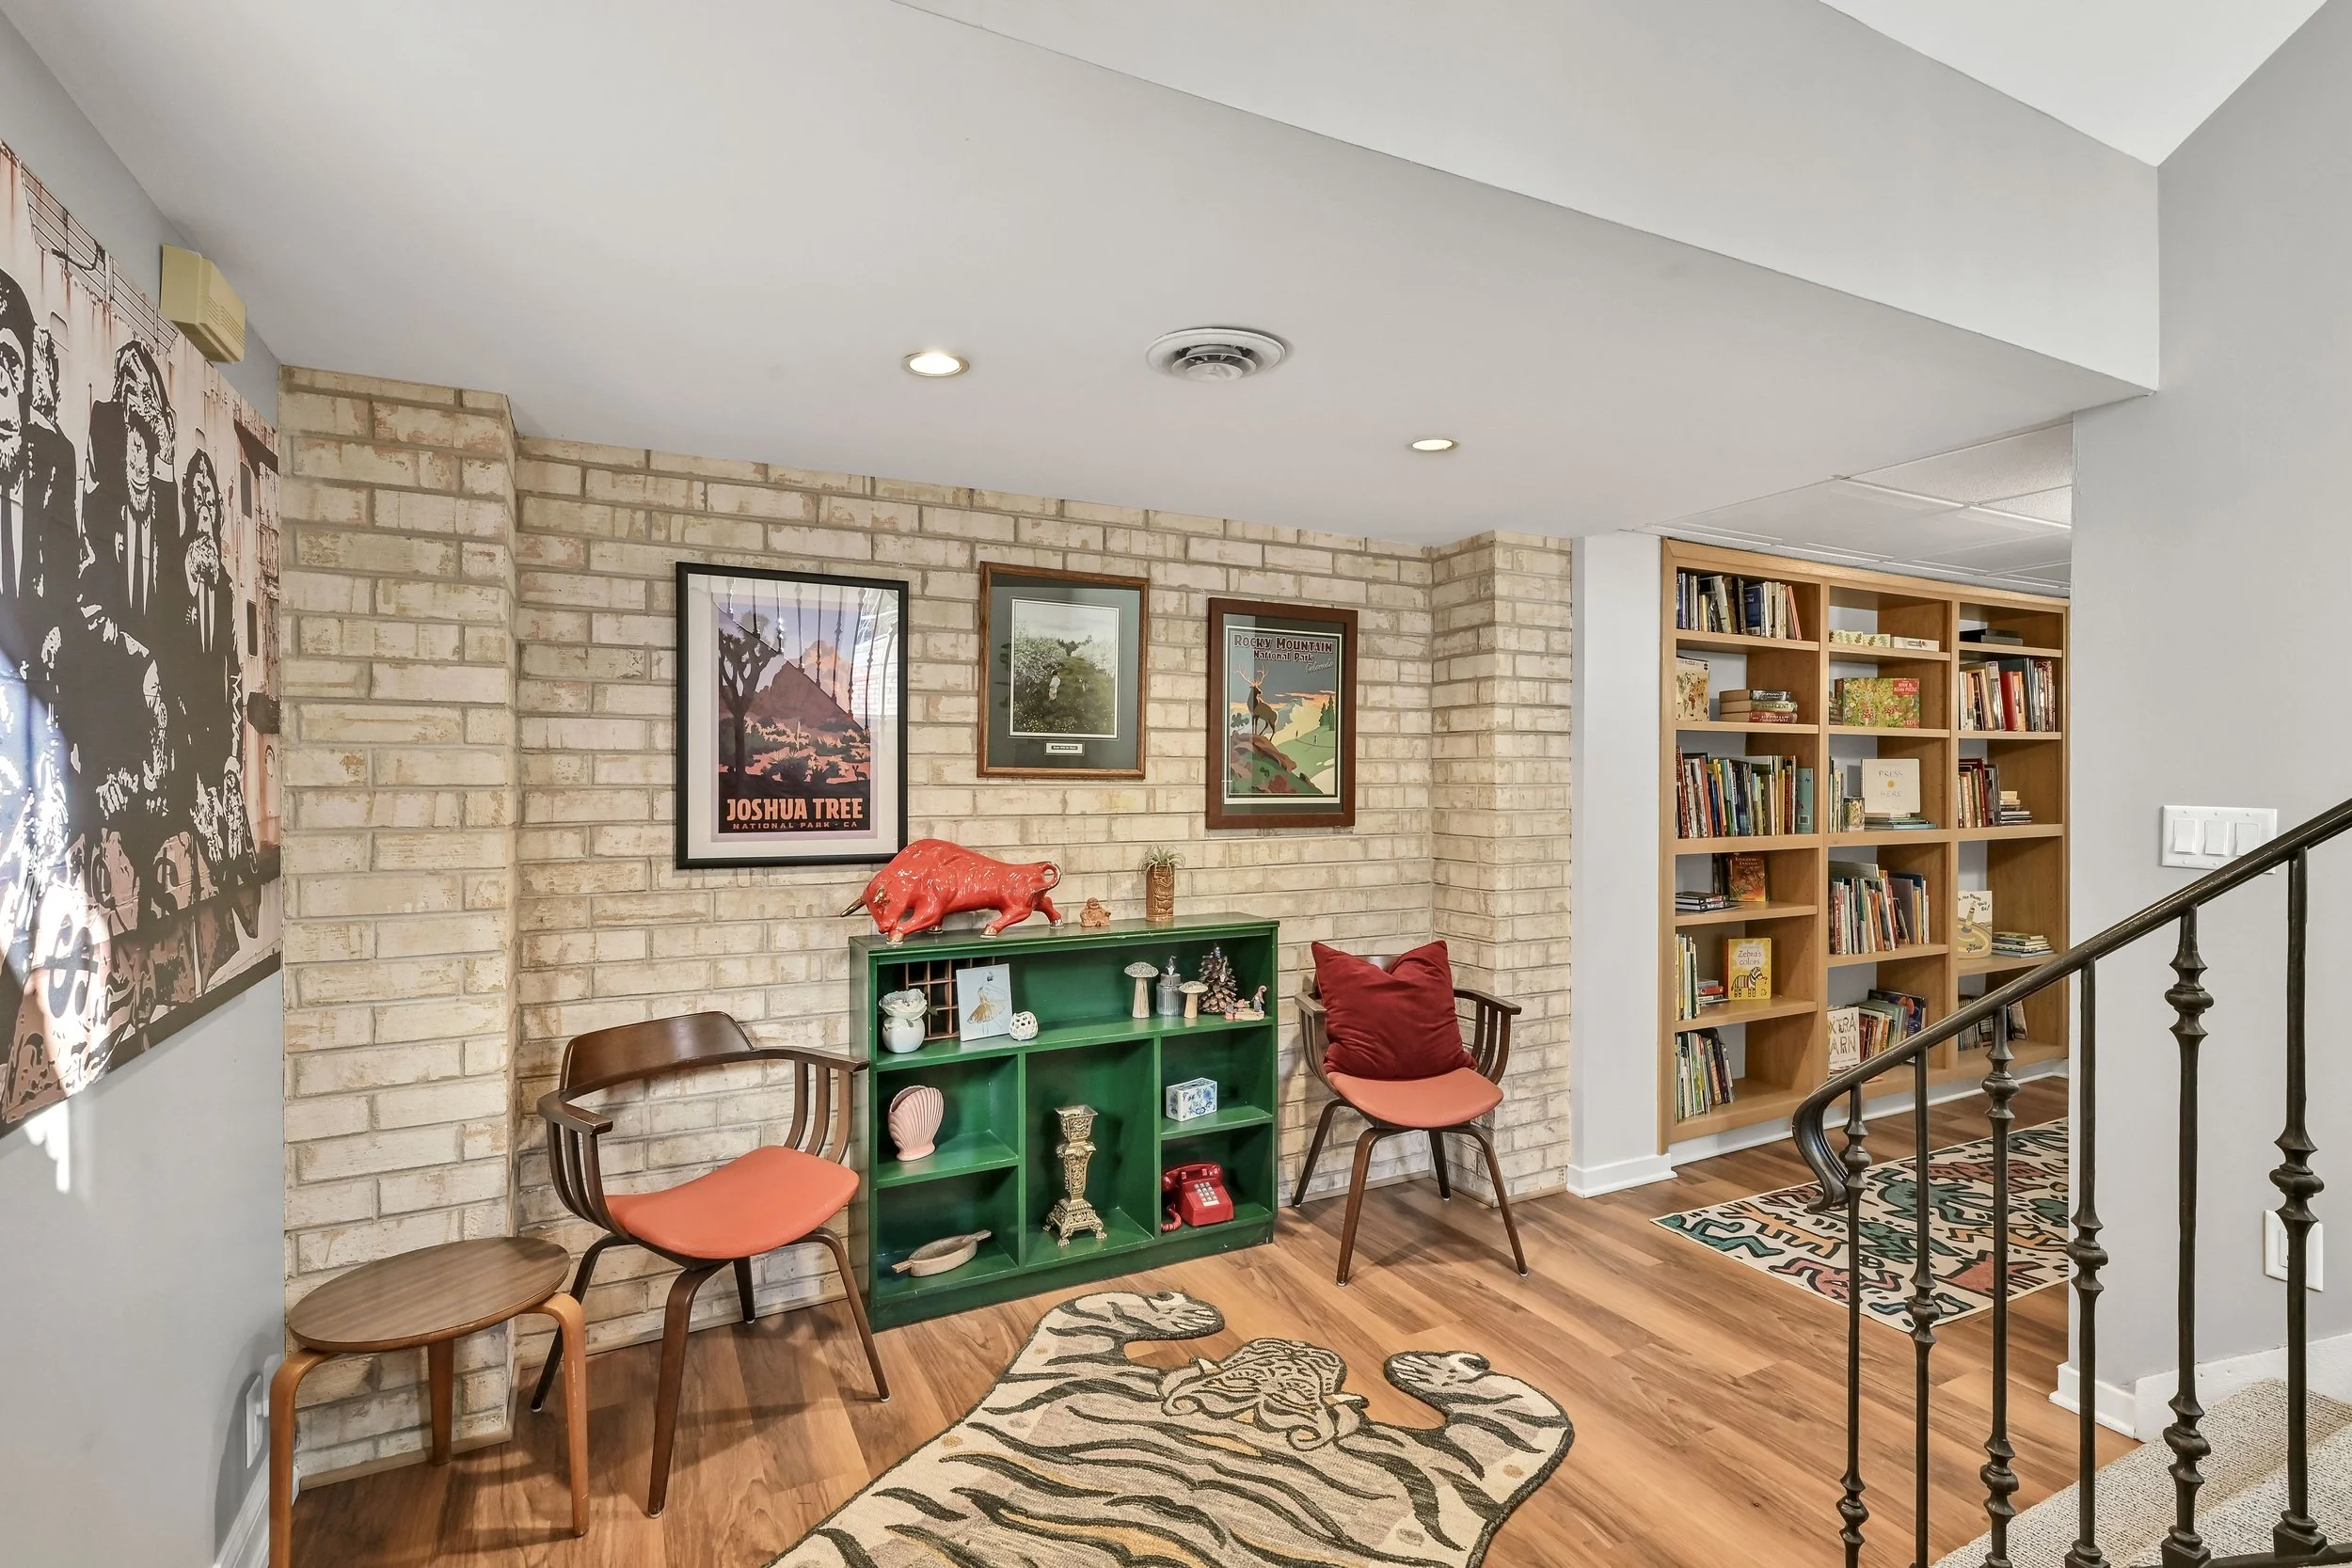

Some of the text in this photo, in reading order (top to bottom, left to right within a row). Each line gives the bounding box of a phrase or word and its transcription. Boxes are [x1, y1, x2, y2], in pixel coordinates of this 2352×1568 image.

[1233, 634, 1333, 654] ROCKY MOUNTAIN
[1253, 649, 1314, 663] National Park
[1878, 769, 1903, 778] PRESS
[726, 798, 864, 821] JOSHUA TREE
[1738, 949, 1762, 958] Zebra's
[1739, 957, 1760, 966] colors
[1828, 1012, 1857, 1035] XTRA
[1829, 1035, 1857, 1056] ARN
